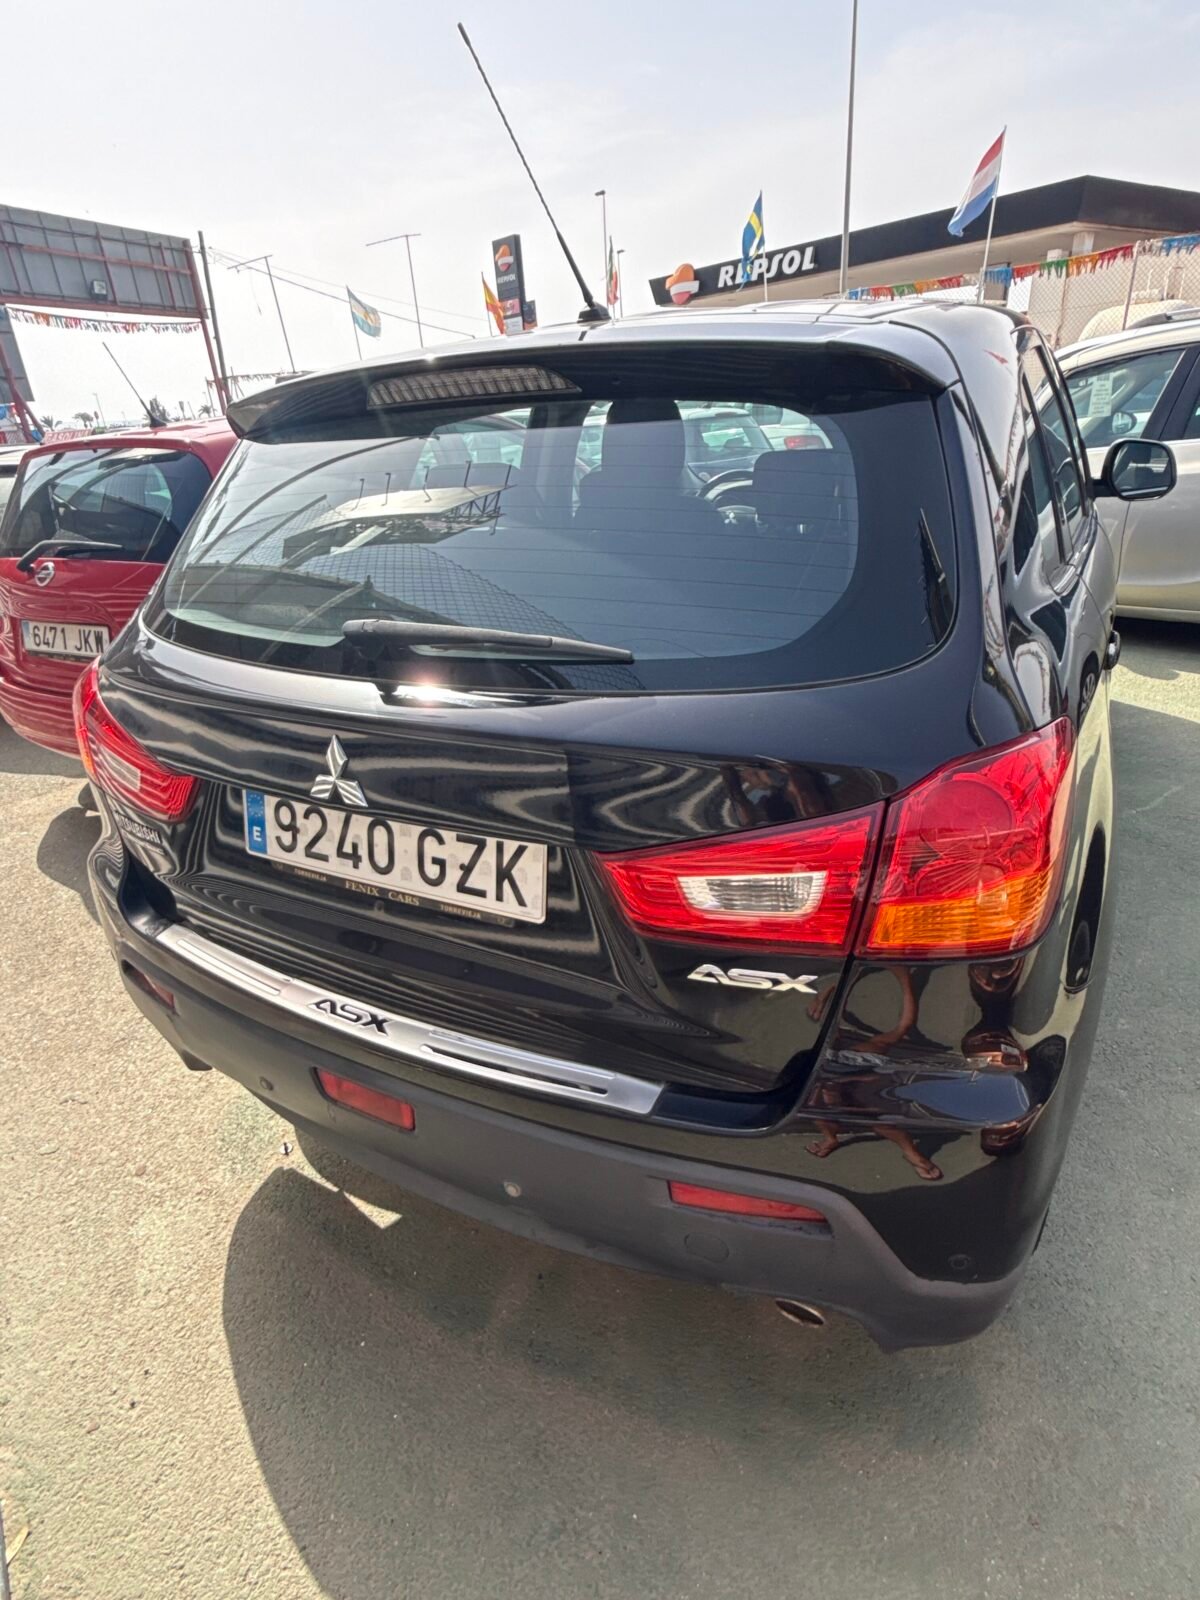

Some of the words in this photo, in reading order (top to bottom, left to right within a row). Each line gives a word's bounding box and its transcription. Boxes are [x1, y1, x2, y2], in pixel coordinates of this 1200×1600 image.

[33, 625, 67, 650] 6471
[75, 628, 104, 653] JKW
[252, 826, 262, 842] E
[274, 798, 395, 876] 9240
[417, 828, 528, 907] GZK
[345, 880, 380, 897] FENIX
[388, 890, 420, 906] CARS
[440, 904, 481, 919] TORREVIEJA
[686, 964, 818, 994] ASX
[314, 999, 390, 1034] ASX
